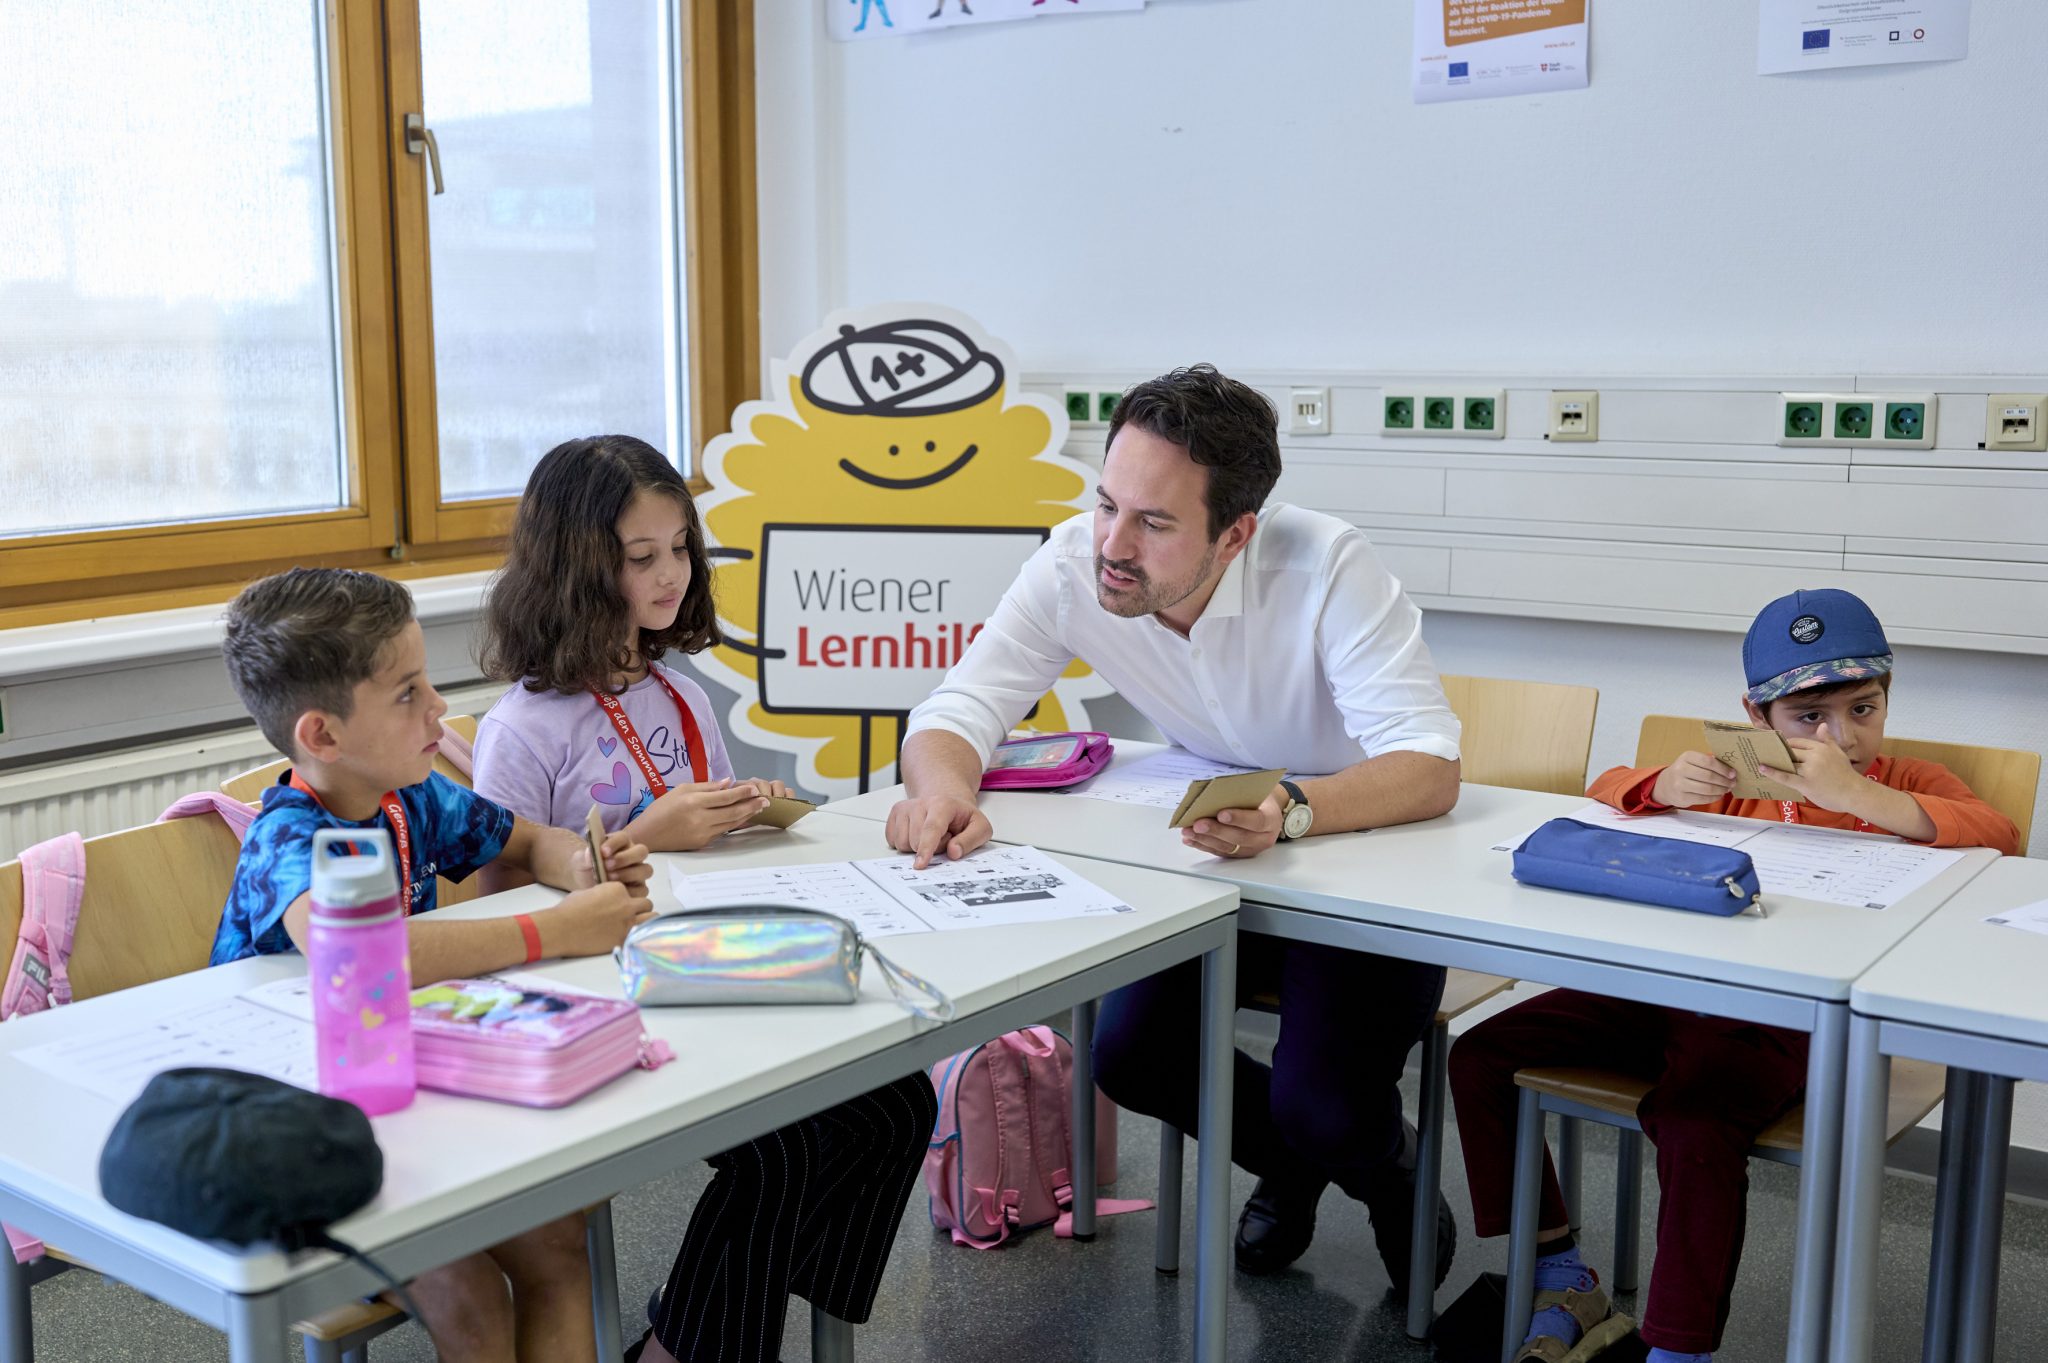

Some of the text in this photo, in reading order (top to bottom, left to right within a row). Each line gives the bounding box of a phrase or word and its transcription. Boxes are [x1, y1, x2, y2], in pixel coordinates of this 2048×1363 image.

[793, 568, 951, 614] Wiener
[798, 622, 985, 669] Lernhil
[613, 711, 629, 734] den
[627, 736, 663, 787] Sommer!
[27, 960, 48, 986] FIL
